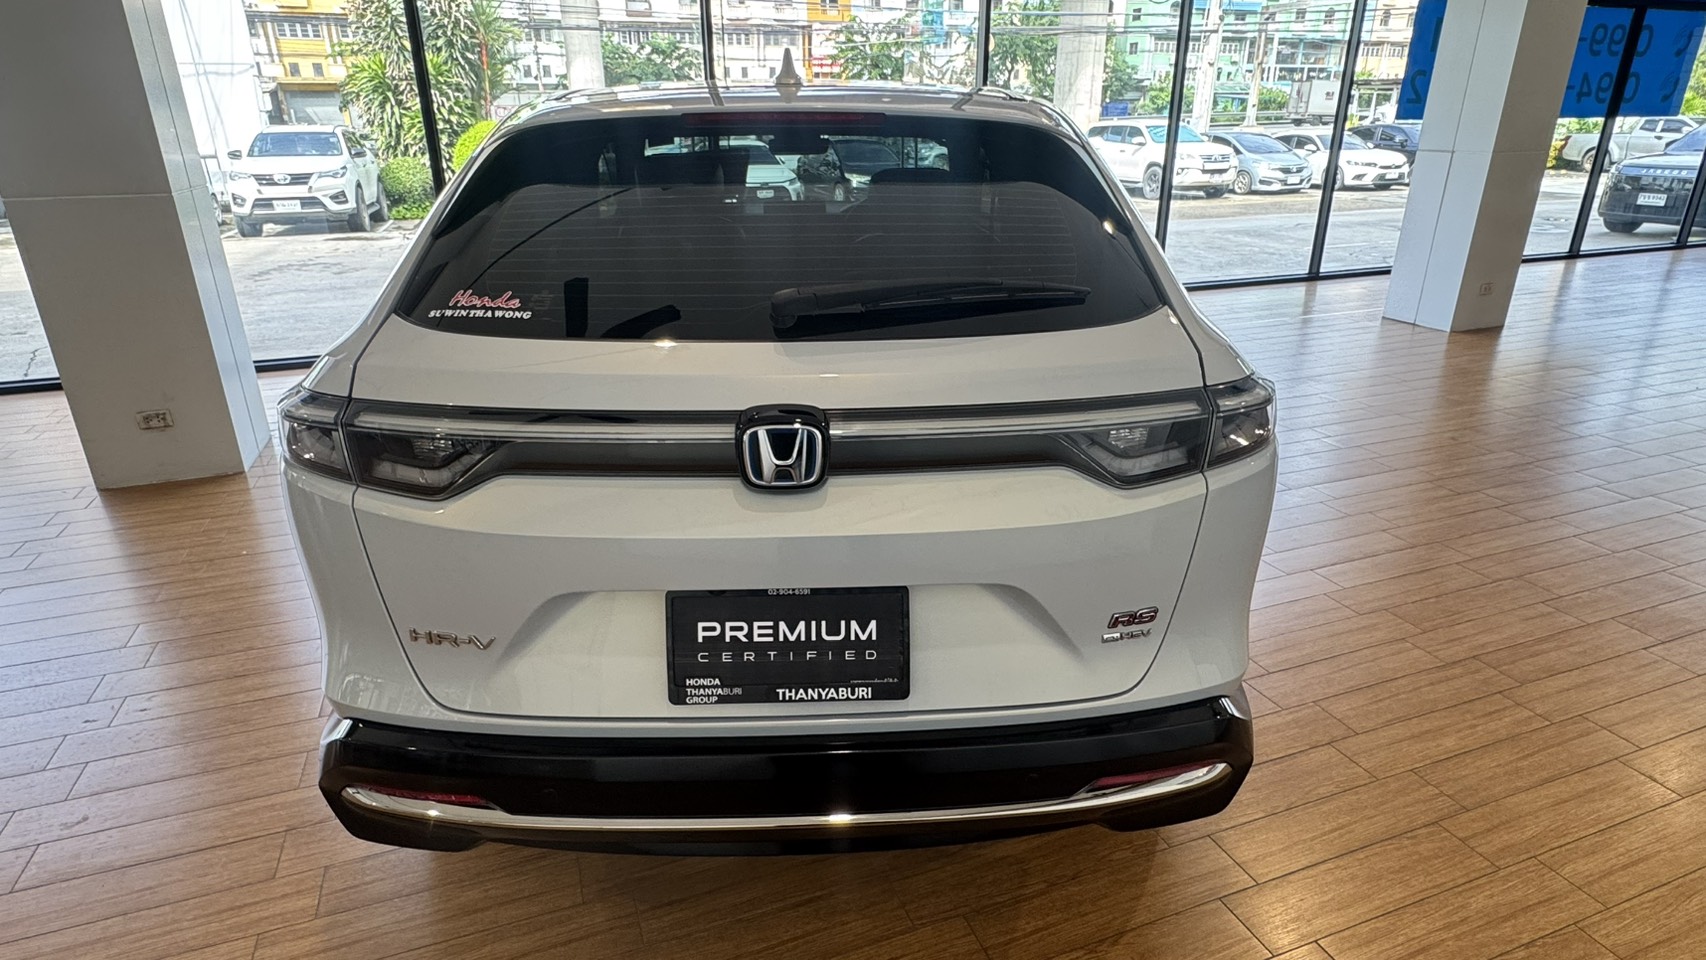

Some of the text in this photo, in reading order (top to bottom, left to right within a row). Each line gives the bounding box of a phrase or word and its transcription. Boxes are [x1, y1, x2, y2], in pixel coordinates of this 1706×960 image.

[448, 289, 522, 308] Honda
[1107, 606, 1159, 629] RS
[409, 626, 496, 650] HR-V
[697, 619, 877, 643] PREMIUM
[697, 650, 877, 662] CERTIFIED
[685, 678, 721, 686] HONDA
[685, 687, 742, 696] THANYABURI
[776, 687, 872, 701] THANYABURI
[685, 696, 718, 704] GROUP
